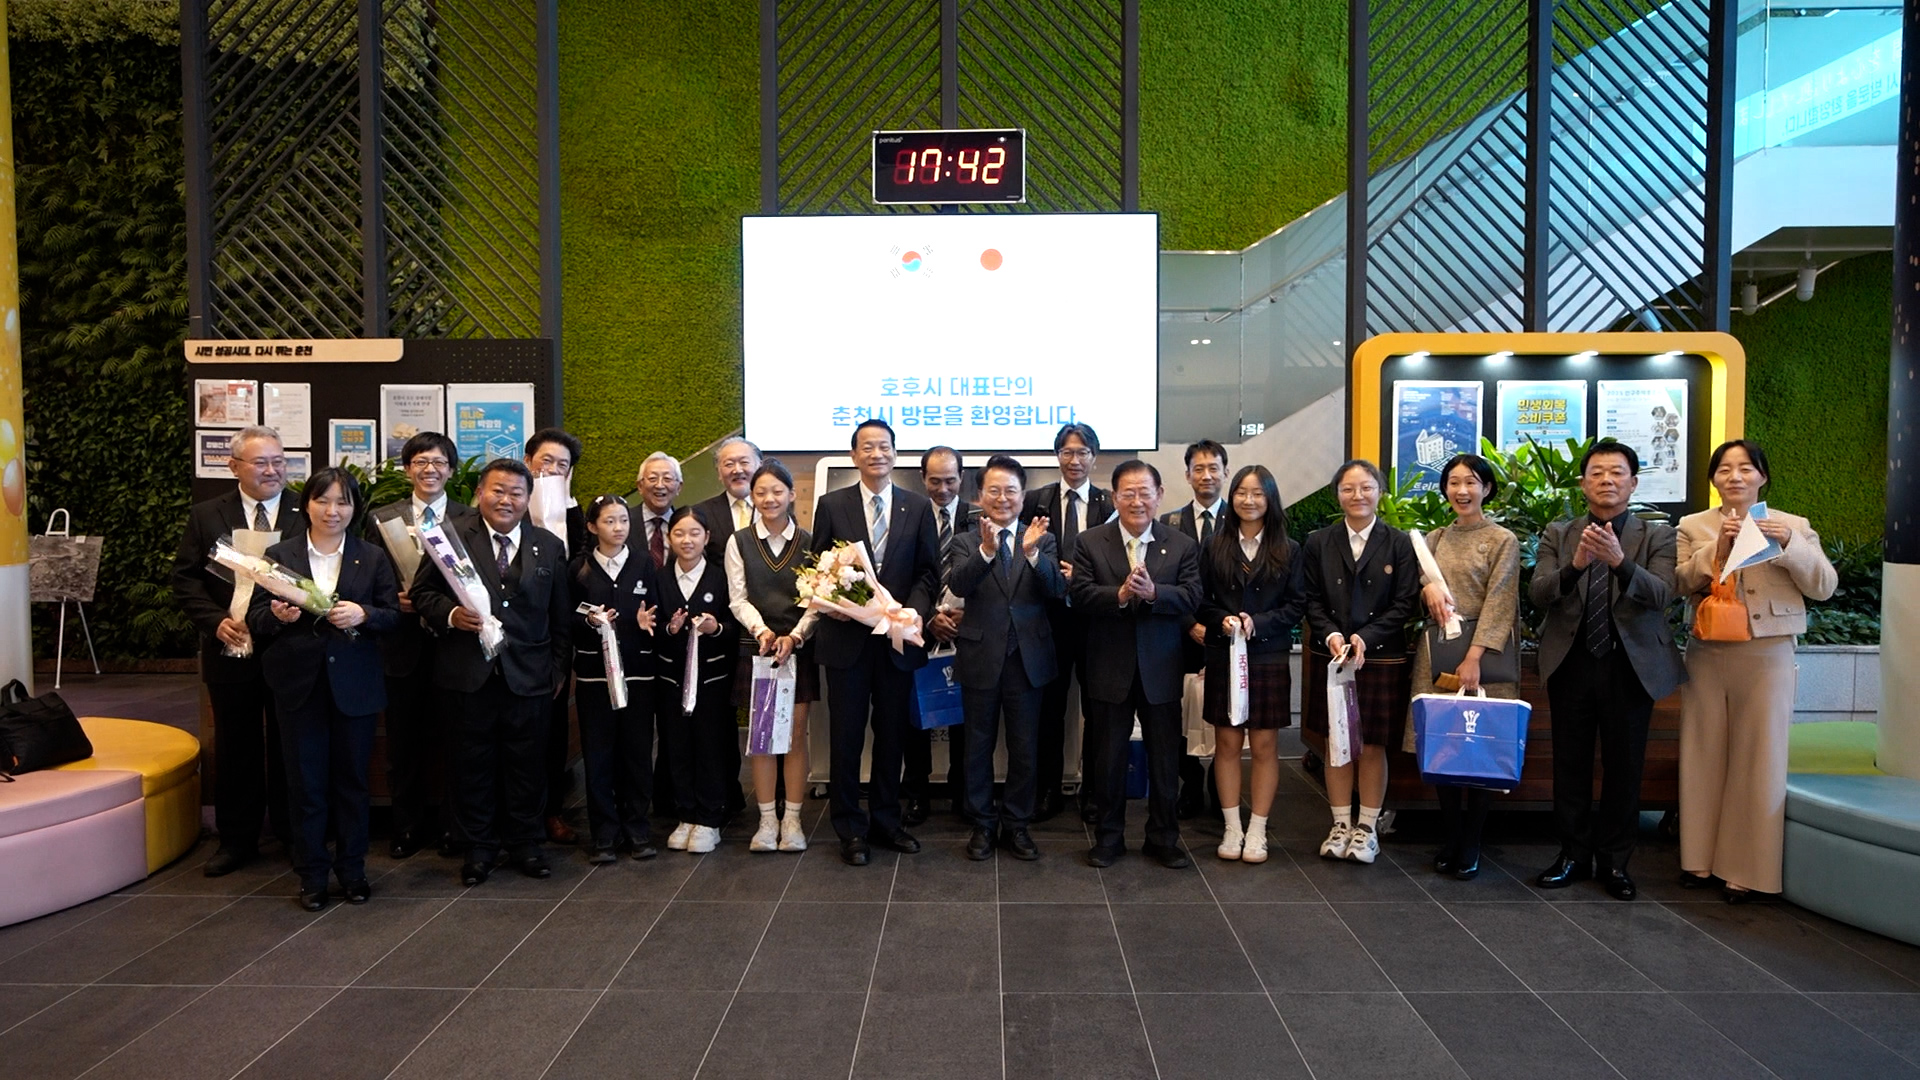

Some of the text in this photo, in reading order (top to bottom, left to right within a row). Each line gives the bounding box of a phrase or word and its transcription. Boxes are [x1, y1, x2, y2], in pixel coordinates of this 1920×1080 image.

[908, 147, 1006, 184] 17:42
[195, 346, 213, 356] 시민
[255, 346, 273, 356] 다시
[275, 346, 293, 356] 뛰는
[295, 346, 313, 356] 춘천
[881, 377, 1033, 397] 호후시 대표단의
[1517, 399, 1567, 412] 민생회복
[832, 406, 893, 427] 춘천시
[902, 406, 963, 426] 방문을
[1517, 412, 1567, 425] 소비쿠폰
